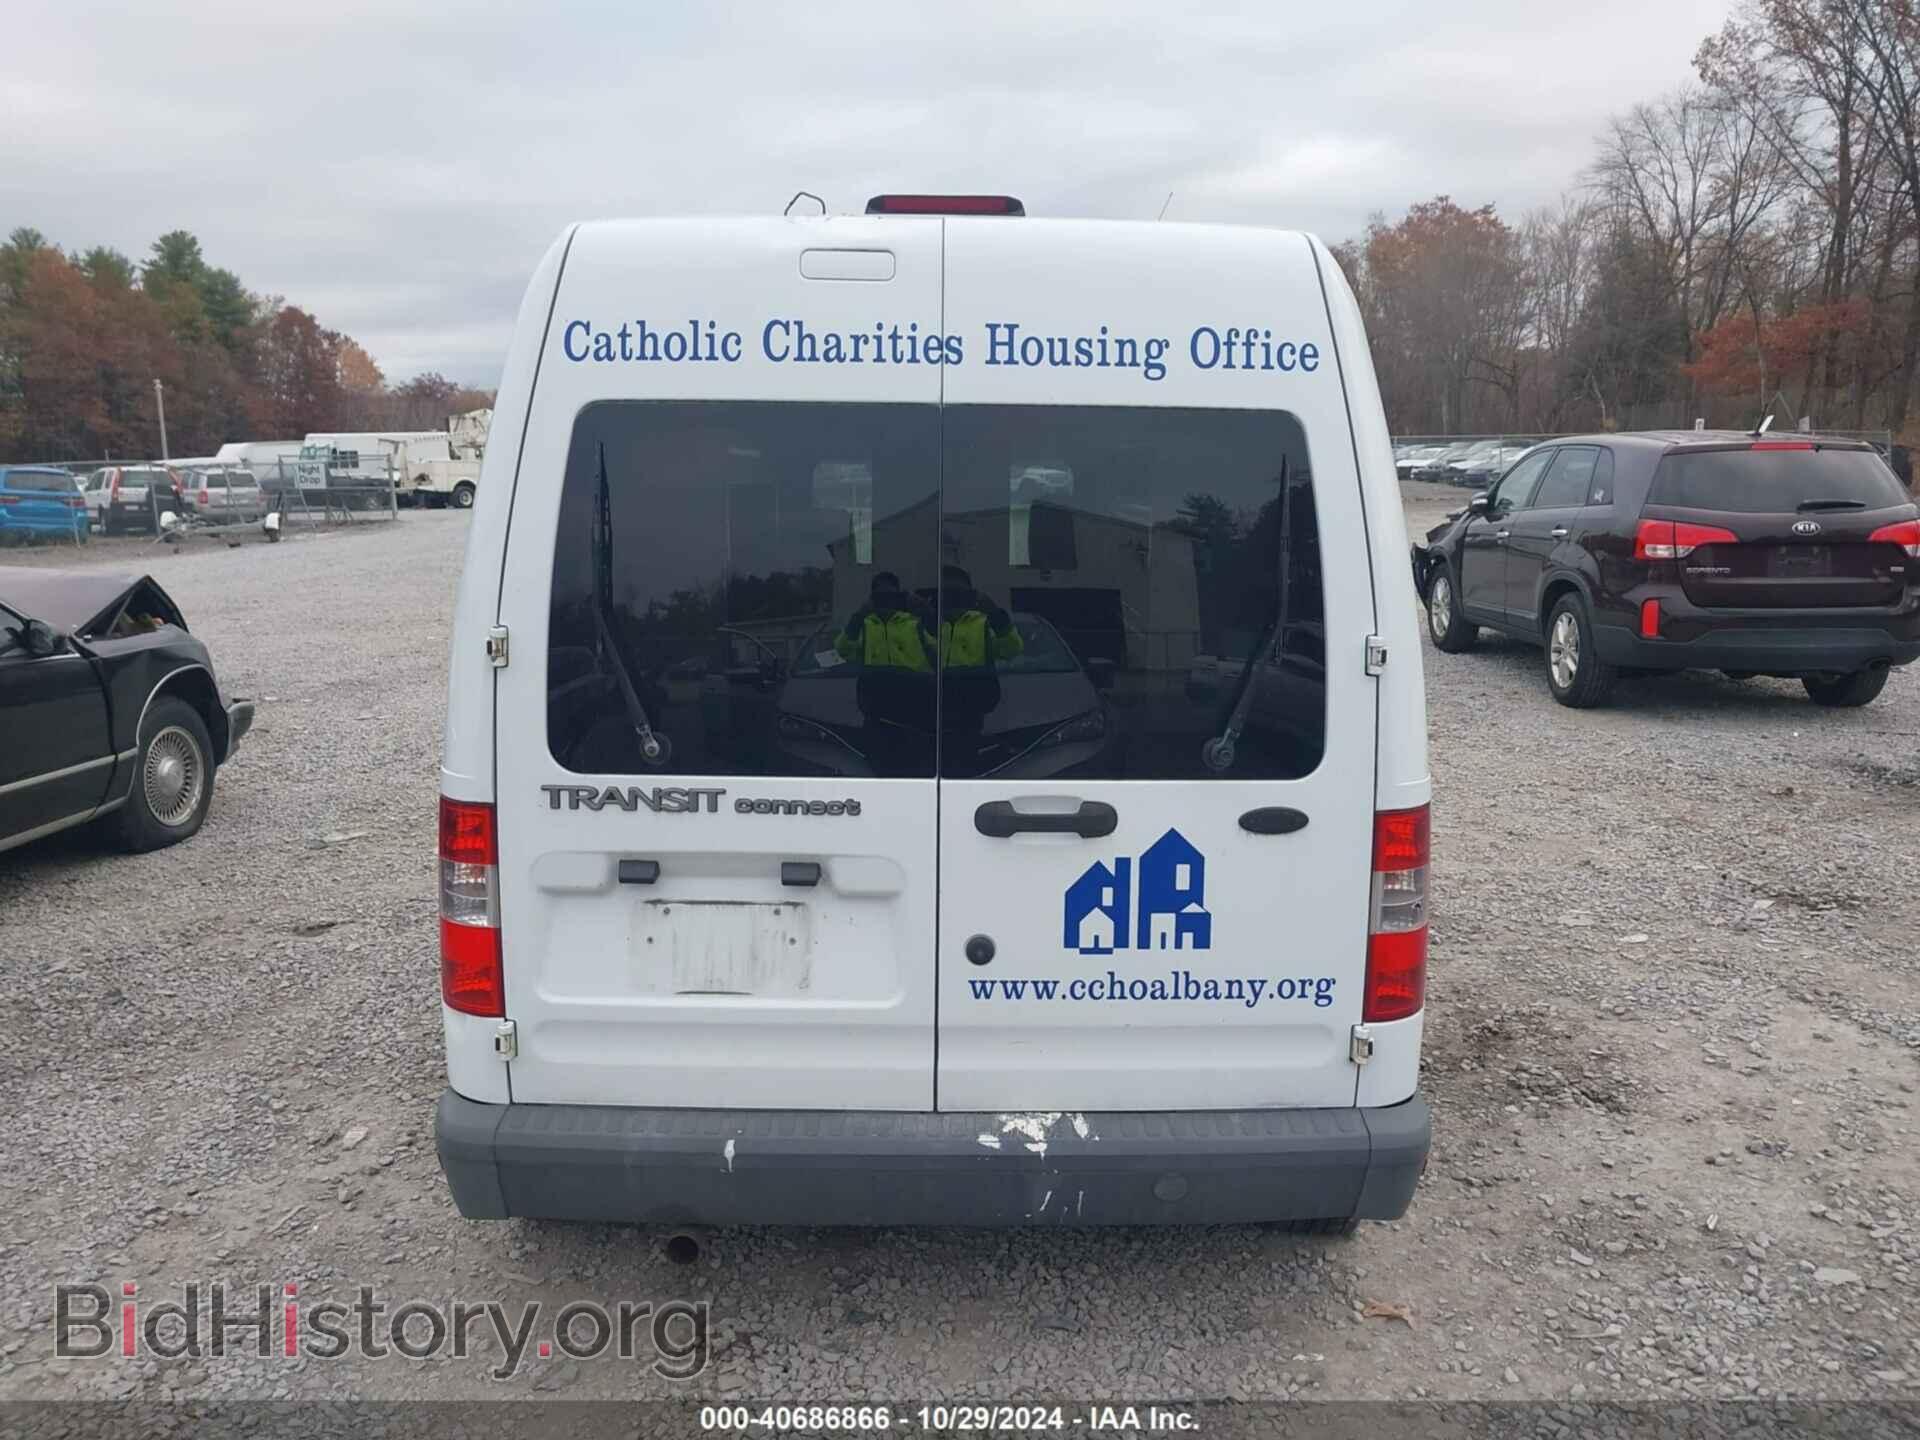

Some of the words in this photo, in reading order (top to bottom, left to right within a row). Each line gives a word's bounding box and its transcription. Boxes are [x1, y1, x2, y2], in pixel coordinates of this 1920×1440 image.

[563, 319, 742, 362] Catholic
[762, 319, 964, 365] Charities
[984, 322, 1170, 381] Housing
[1189, 326, 1320, 372] Office
[298, 463, 320, 476] Night
[299, 476, 321, 486] Drop
[541, 784, 726, 813] TRANSIT
[734, 798, 861, 815] connect
[968, 971, 1337, 1008] www.cchoalbany.org
